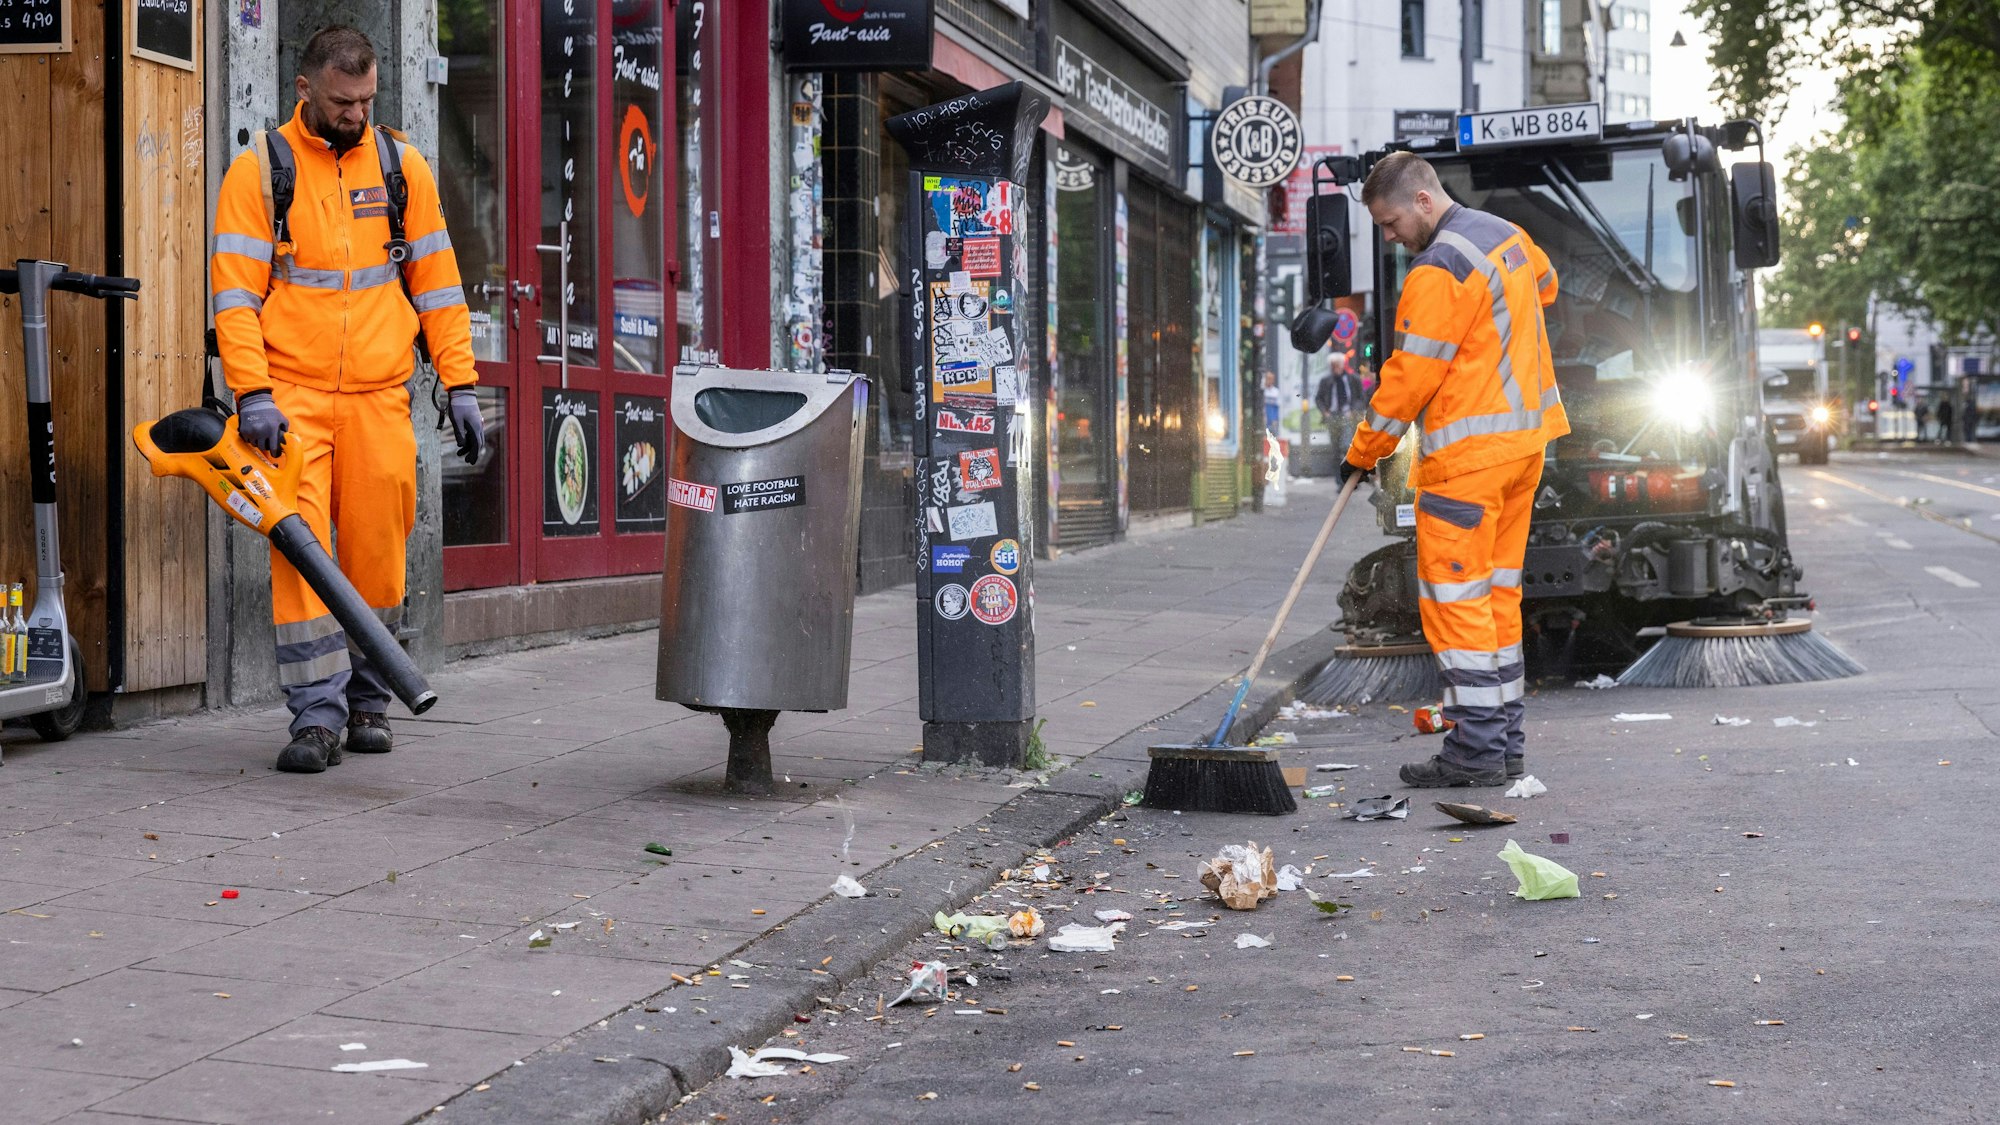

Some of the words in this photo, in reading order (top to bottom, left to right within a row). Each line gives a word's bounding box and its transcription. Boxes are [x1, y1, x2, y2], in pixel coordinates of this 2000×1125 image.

[22, 12, 53, 29] 4,90
[863, 11, 880, 19] Sushi
[809, 22, 892, 45] Fant-asia
[614, 44, 660, 91] Fant-asia
[1218, 100, 1294, 136] FRISEUR
[1481, 118, 1495, 139] K
[1512, 115, 1540, 136] WB
[1547, 110, 1588, 133] 884
[1241, 125, 1273, 158] K&B
[1219, 149, 1294, 183] 9383320
[621, 317, 637, 331] Sushi
[637, 320, 643, 335] &
[555, 394, 586, 418] Fant-asia
[625, 401, 654, 424] Fant-asia
[727, 484, 751, 495] LOVE
[753, 478, 799, 491] FOOTBALL
[734, 498, 759, 509] HATE
[761, 493, 796, 505] RACISM
